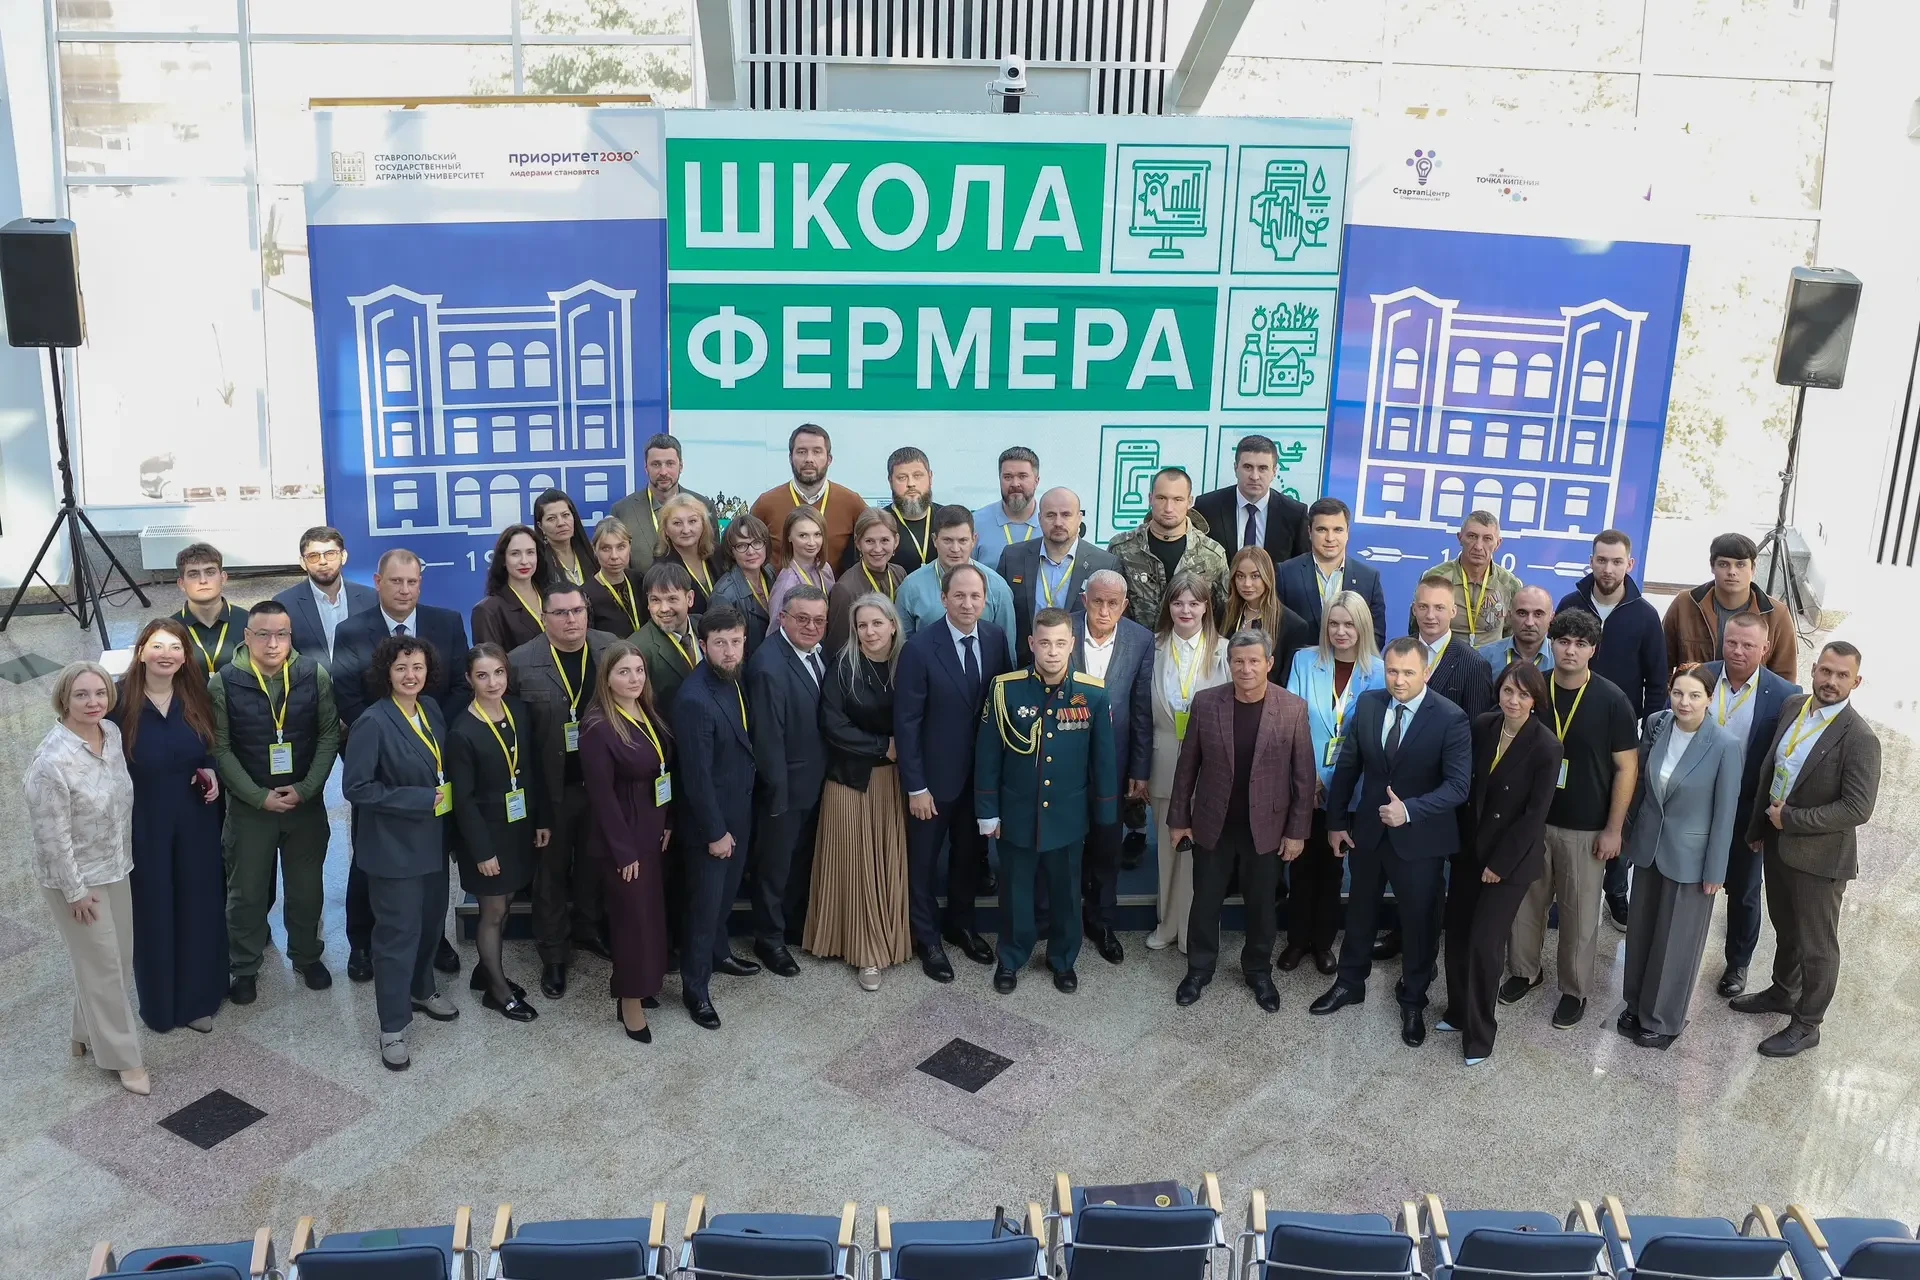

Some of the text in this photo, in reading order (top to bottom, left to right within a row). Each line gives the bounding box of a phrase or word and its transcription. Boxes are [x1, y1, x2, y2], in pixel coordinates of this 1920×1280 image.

[374, 152, 457, 162] СТАВРОПОЛЬСКИЙ
[374, 162, 462, 172] ГОСУДАРСТВЕННЫЙ
[375, 171, 485, 181] АГРАРНЫЙ УНИВЕРСИТЕТ
[509, 168, 600, 178] лидерами становятся
[1476, 176, 1501, 184] ТОЧКА
[1503, 178, 1540, 186] КИПЕНИЯ
[1392, 187, 1451, 198] СтартапЦентр
[684, 161, 1084, 252] ШКОЛА
[687, 305, 1194, 390] ФЕРМЕРА
